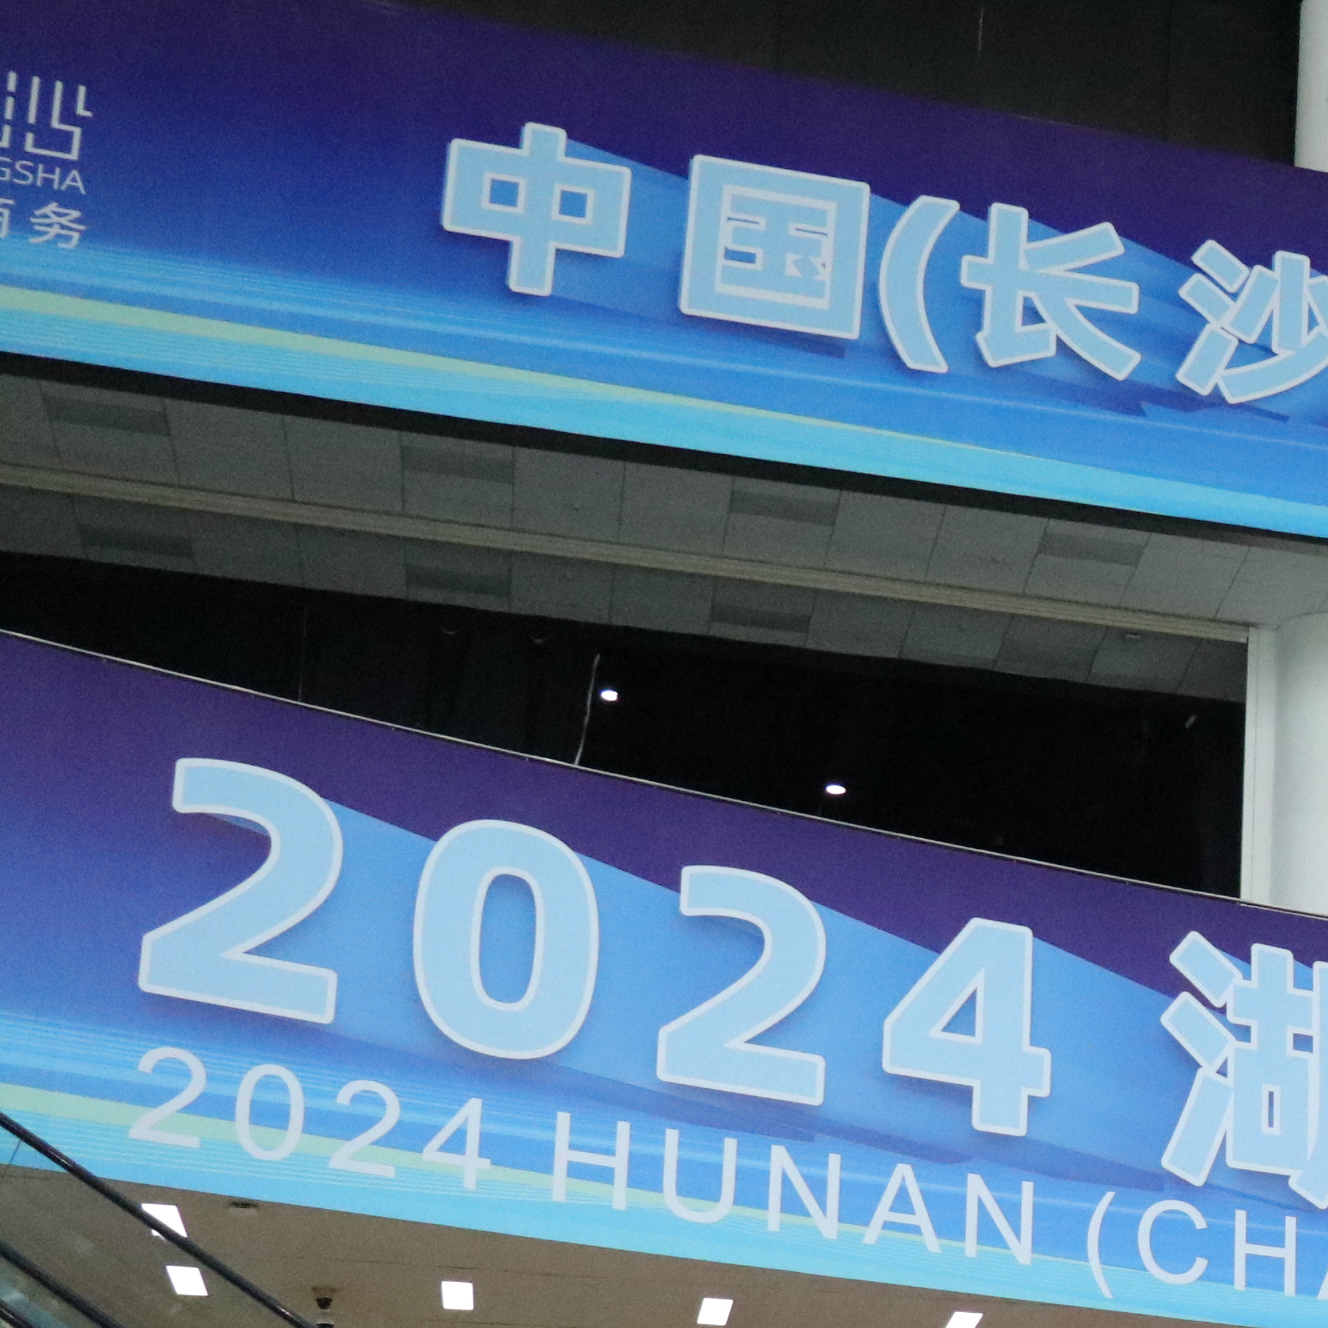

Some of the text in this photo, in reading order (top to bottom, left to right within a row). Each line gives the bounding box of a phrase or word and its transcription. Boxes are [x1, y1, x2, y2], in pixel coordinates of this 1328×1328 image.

[138, 757, 1052, 1137] 2024
[128, 1045, 492, 1190] 2024
[551, 1110, 1035, 1266] HUNAN
